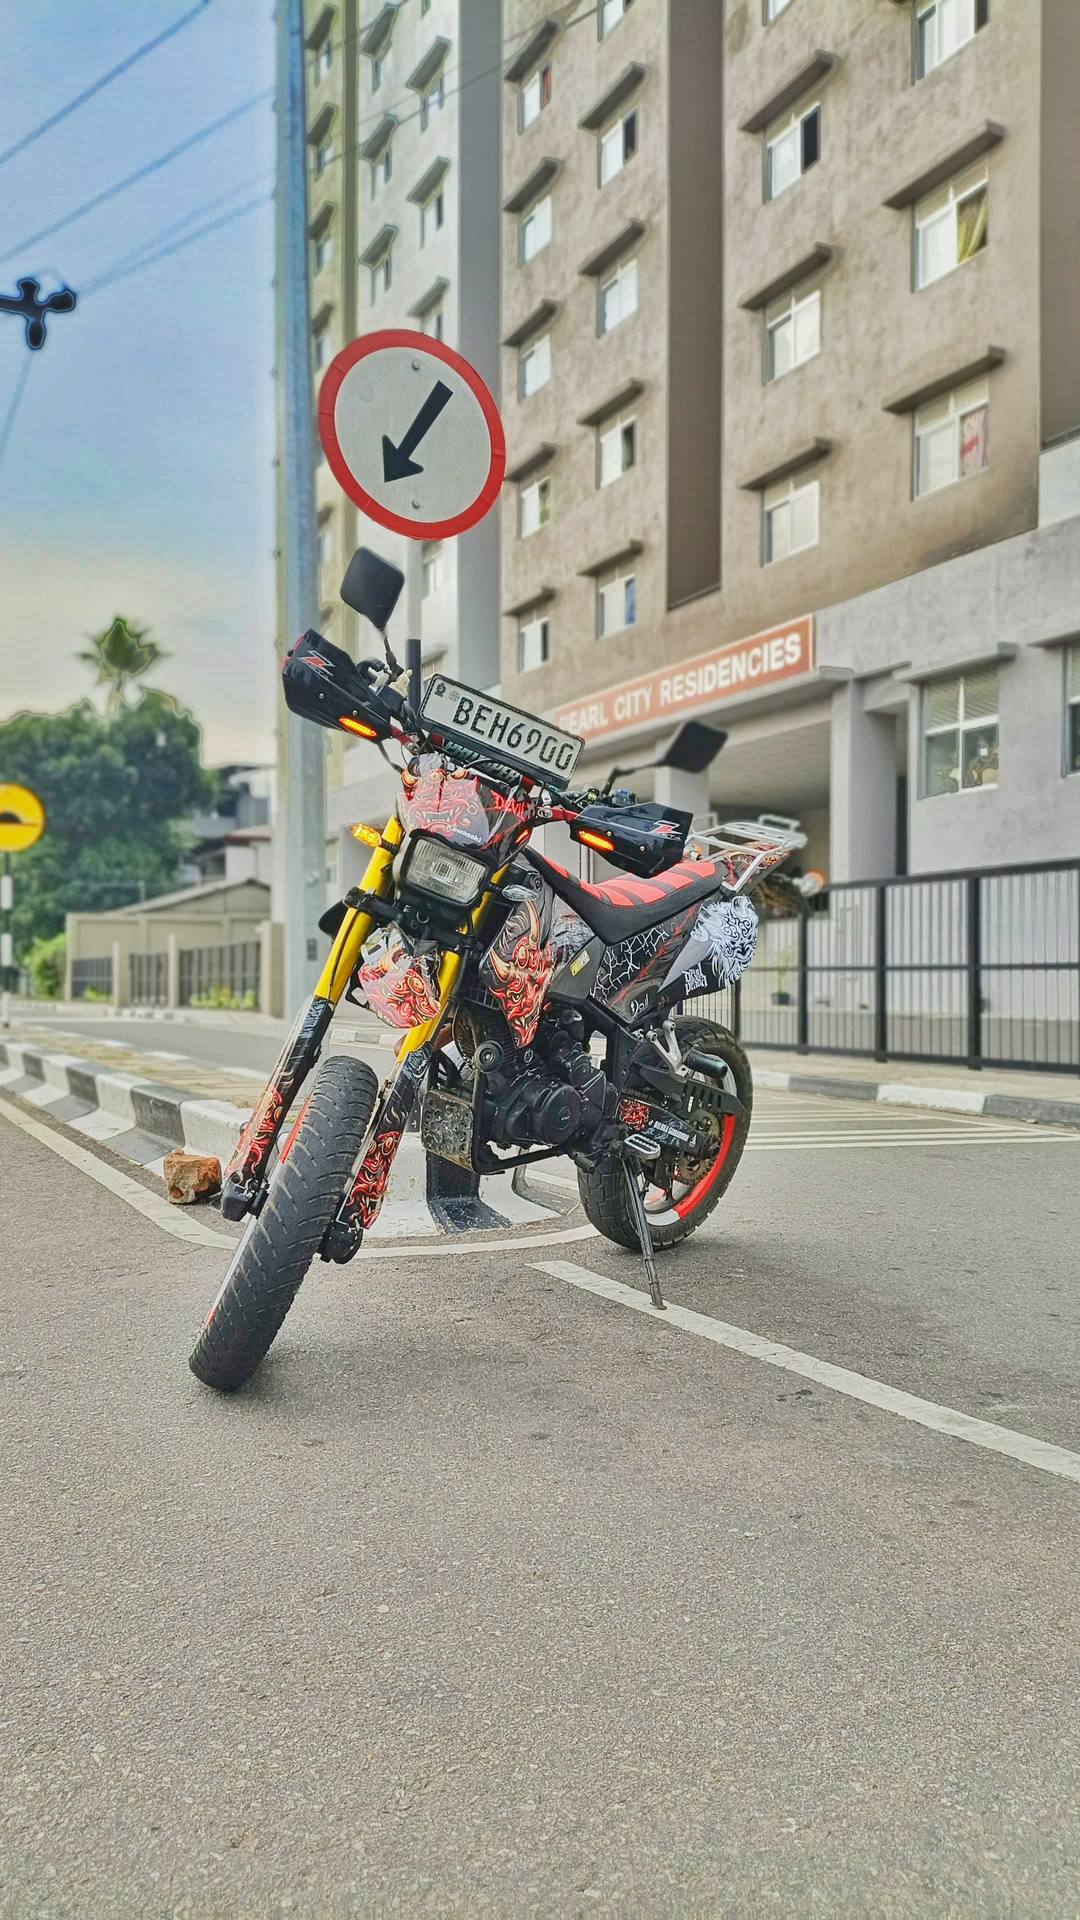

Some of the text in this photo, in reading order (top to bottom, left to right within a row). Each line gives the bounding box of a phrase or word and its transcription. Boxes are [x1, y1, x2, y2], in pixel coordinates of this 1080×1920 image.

[559, 633, 802, 733] PEARL CITY RESIDENCIES
[447, 823, 482, 844] Kawasaki
